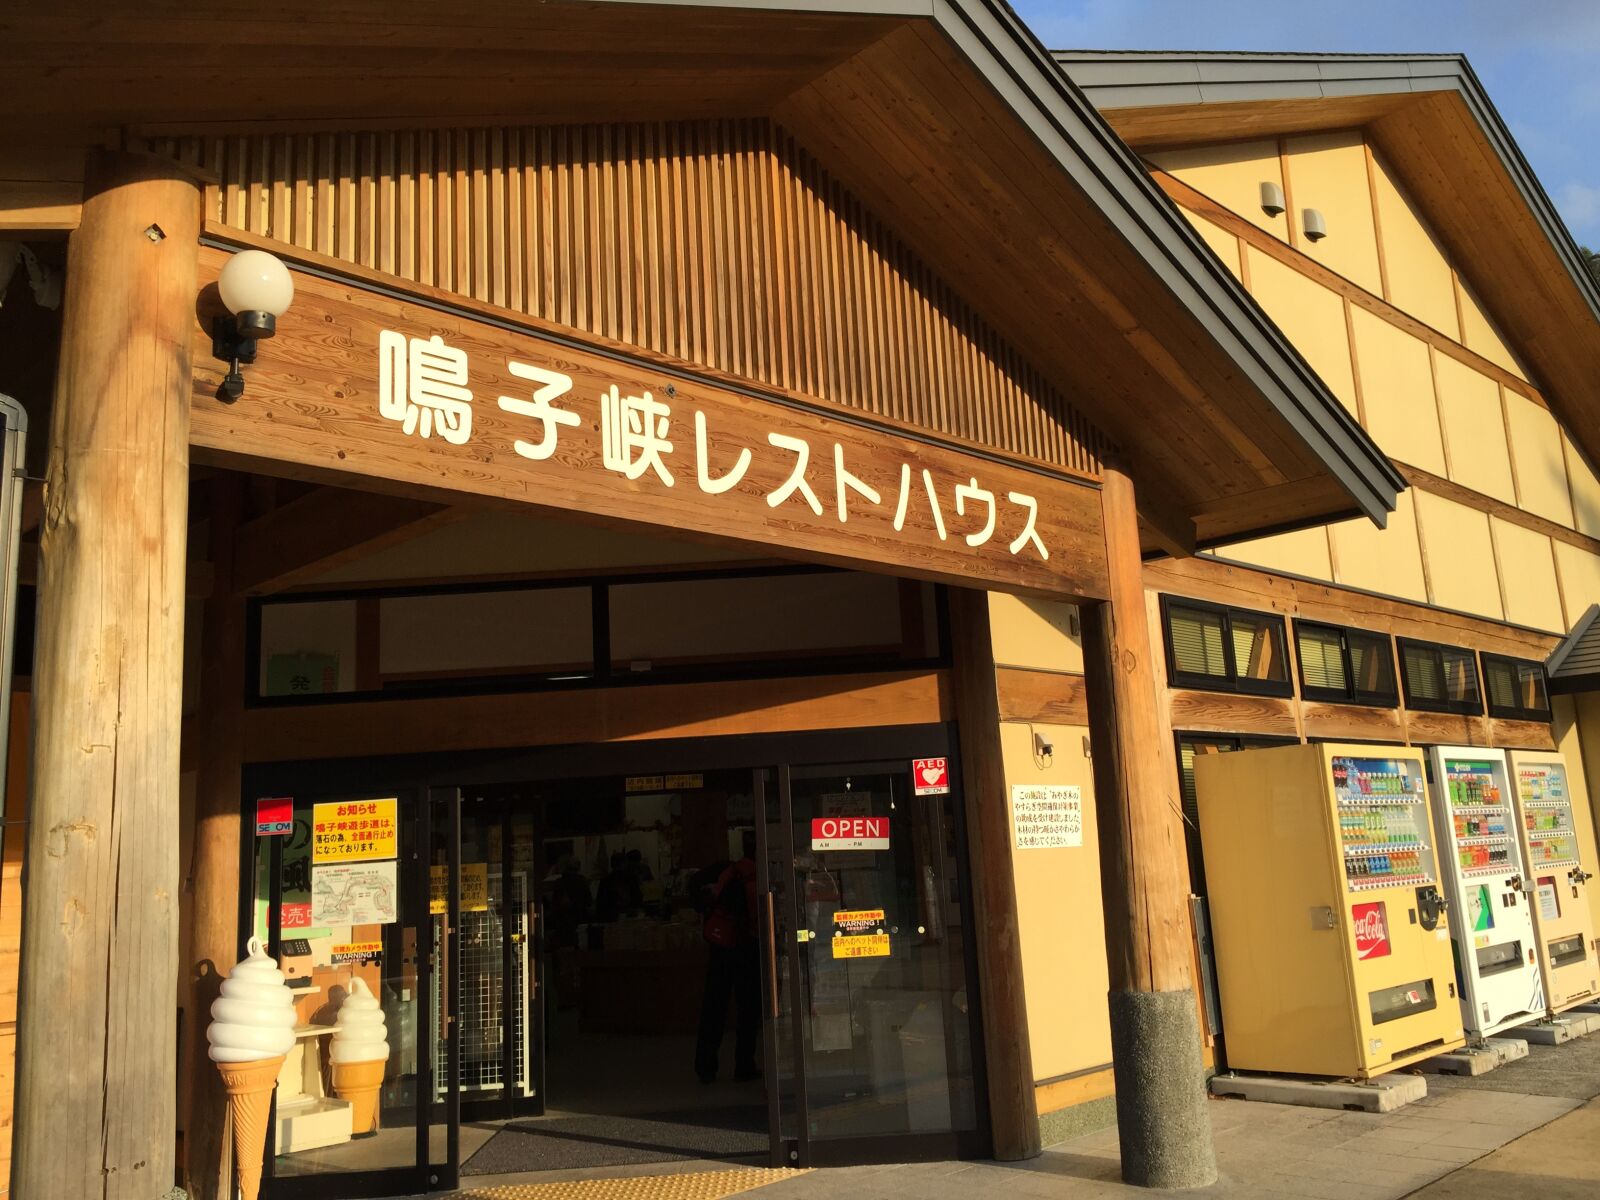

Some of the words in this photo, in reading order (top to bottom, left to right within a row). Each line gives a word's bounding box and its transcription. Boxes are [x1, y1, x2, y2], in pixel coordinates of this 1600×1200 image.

[378, 329, 1049, 561] 鳴子峡レストハウス
[916, 759, 945, 769] AED
[336, 803, 377, 817] お知らせ
[259, 822, 291, 832] SEOM
[821, 819, 880, 838] OPEN
[315, 842, 378, 855] になっております。
